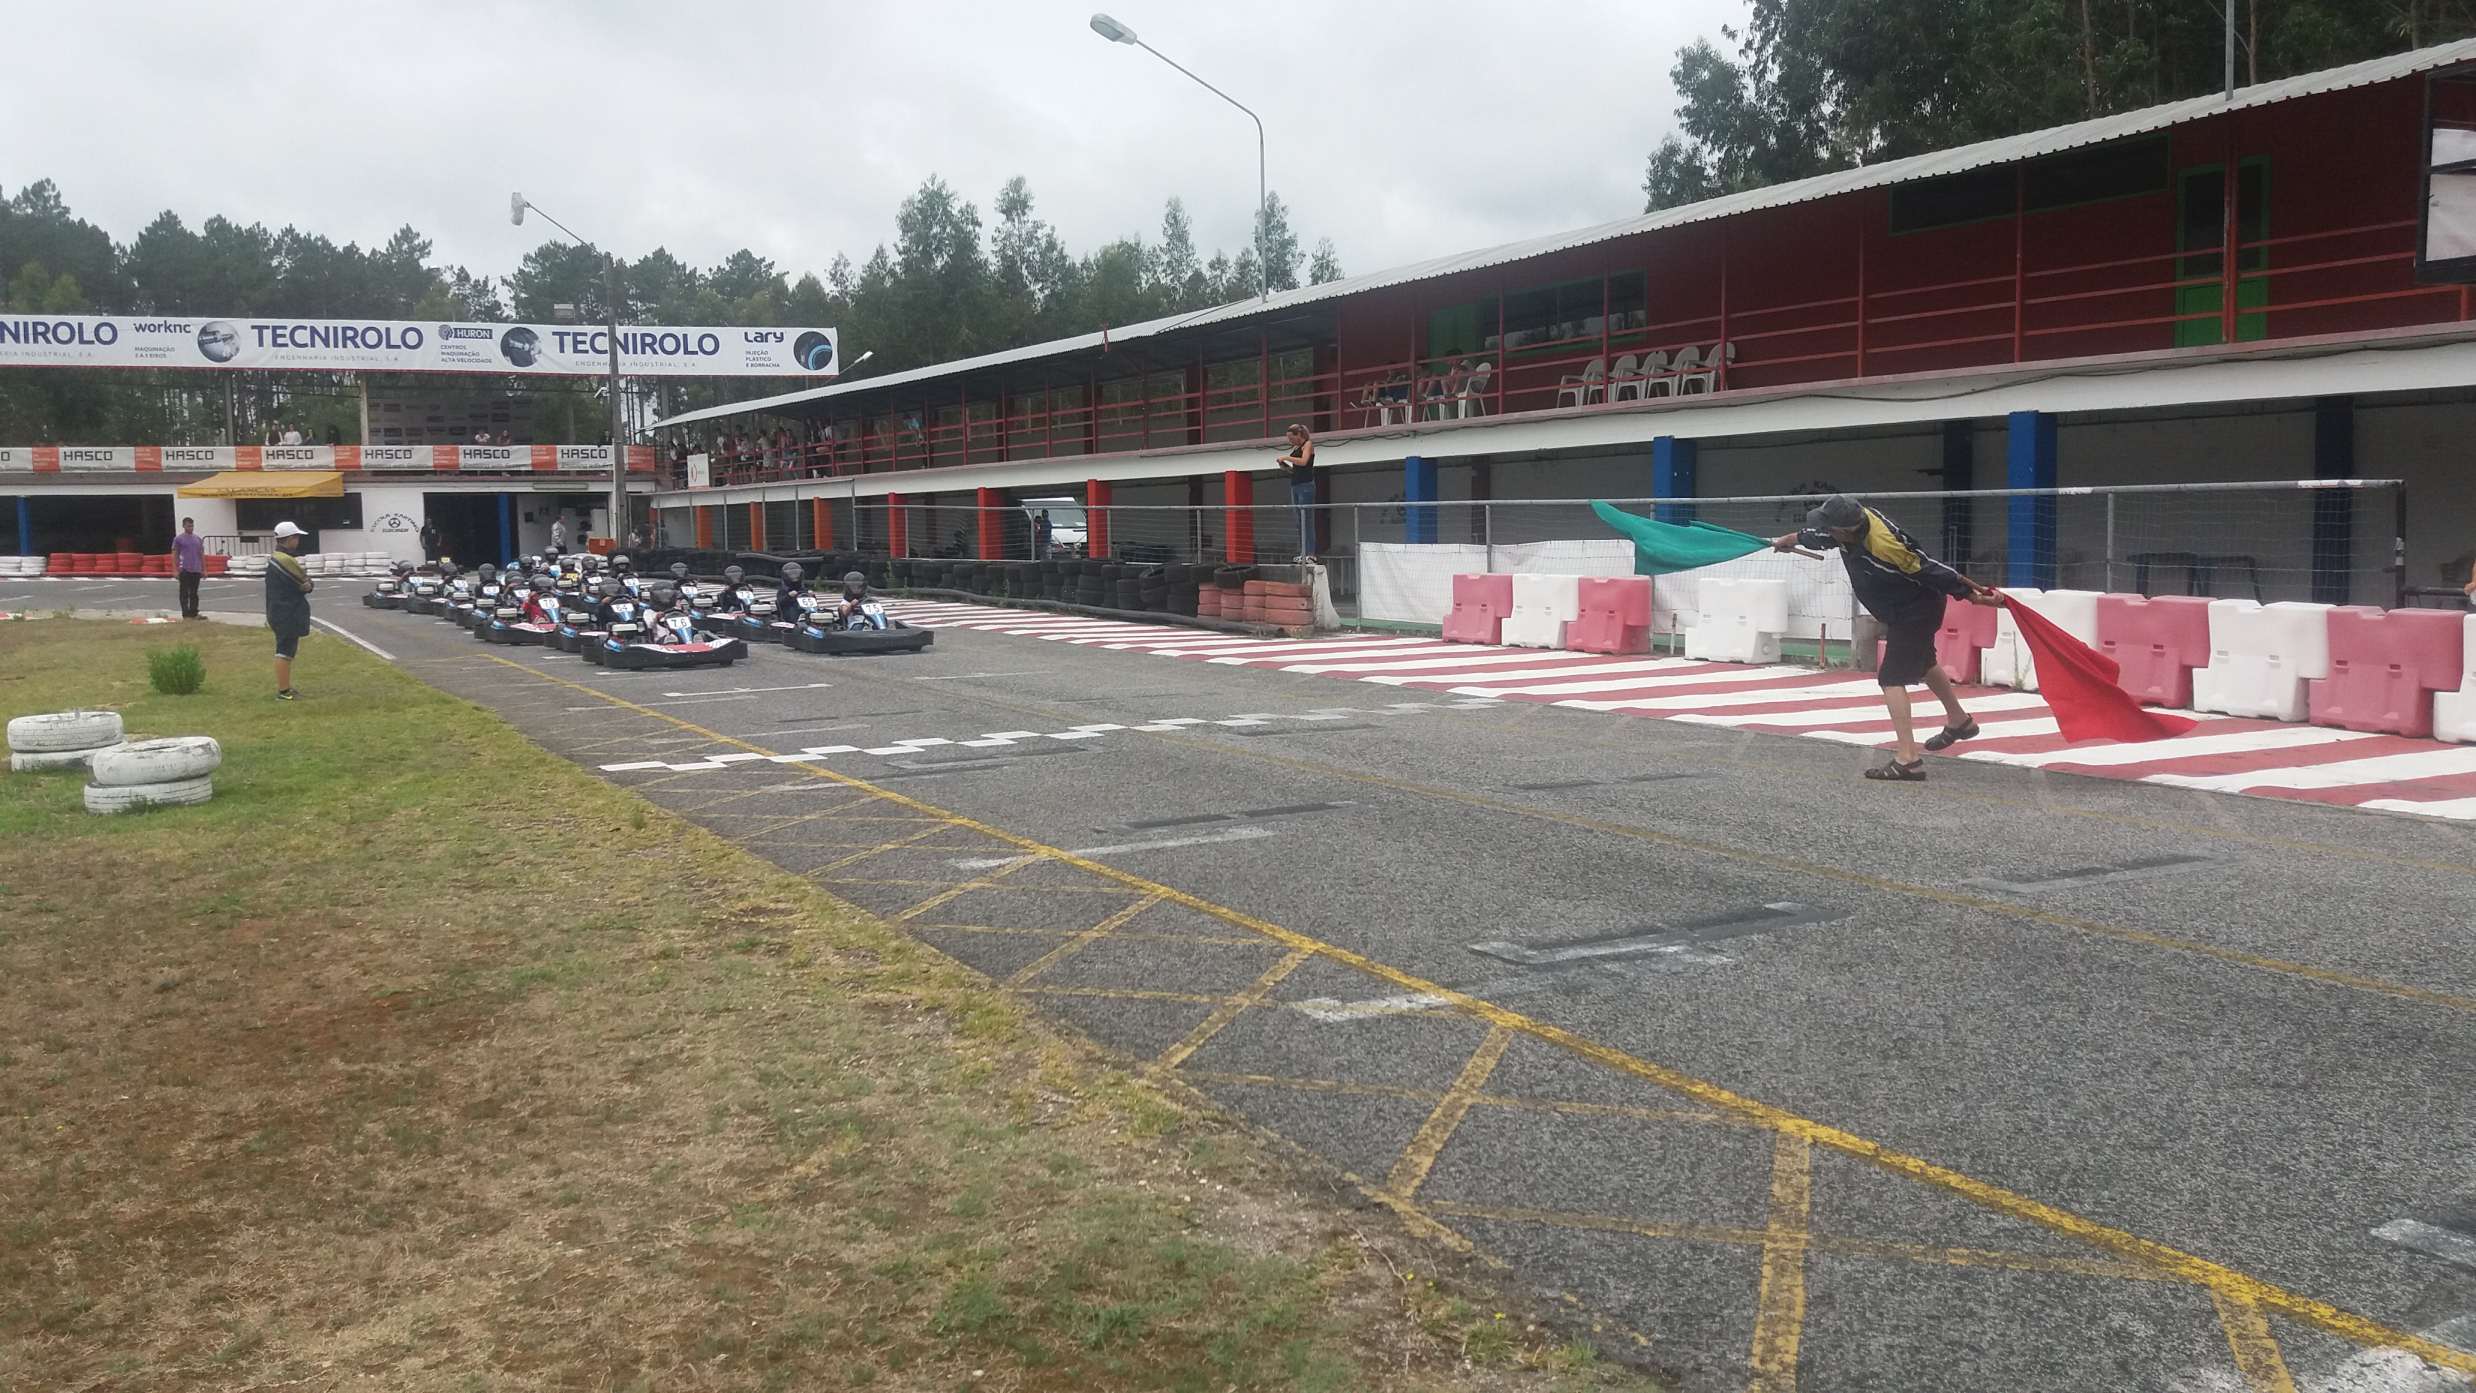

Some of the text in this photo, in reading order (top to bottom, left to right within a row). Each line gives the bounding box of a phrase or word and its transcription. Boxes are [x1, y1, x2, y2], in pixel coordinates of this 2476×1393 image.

[134, 320, 191, 334] worknc
[251, 325, 424, 350] TECNIROLO
[456, 328, 490, 339] HURON
[63, 450, 113, 462] HASCO
[165, 449, 215, 461] HASCO
[265, 448, 314, 460] HASCO
[364, 448, 413, 460] HASCO
[463, 448, 511, 460] HASCO
[560, 447, 608, 459] HASCO
[865, 603, 881, 613] 75
[670, 618, 688, 628] 76
